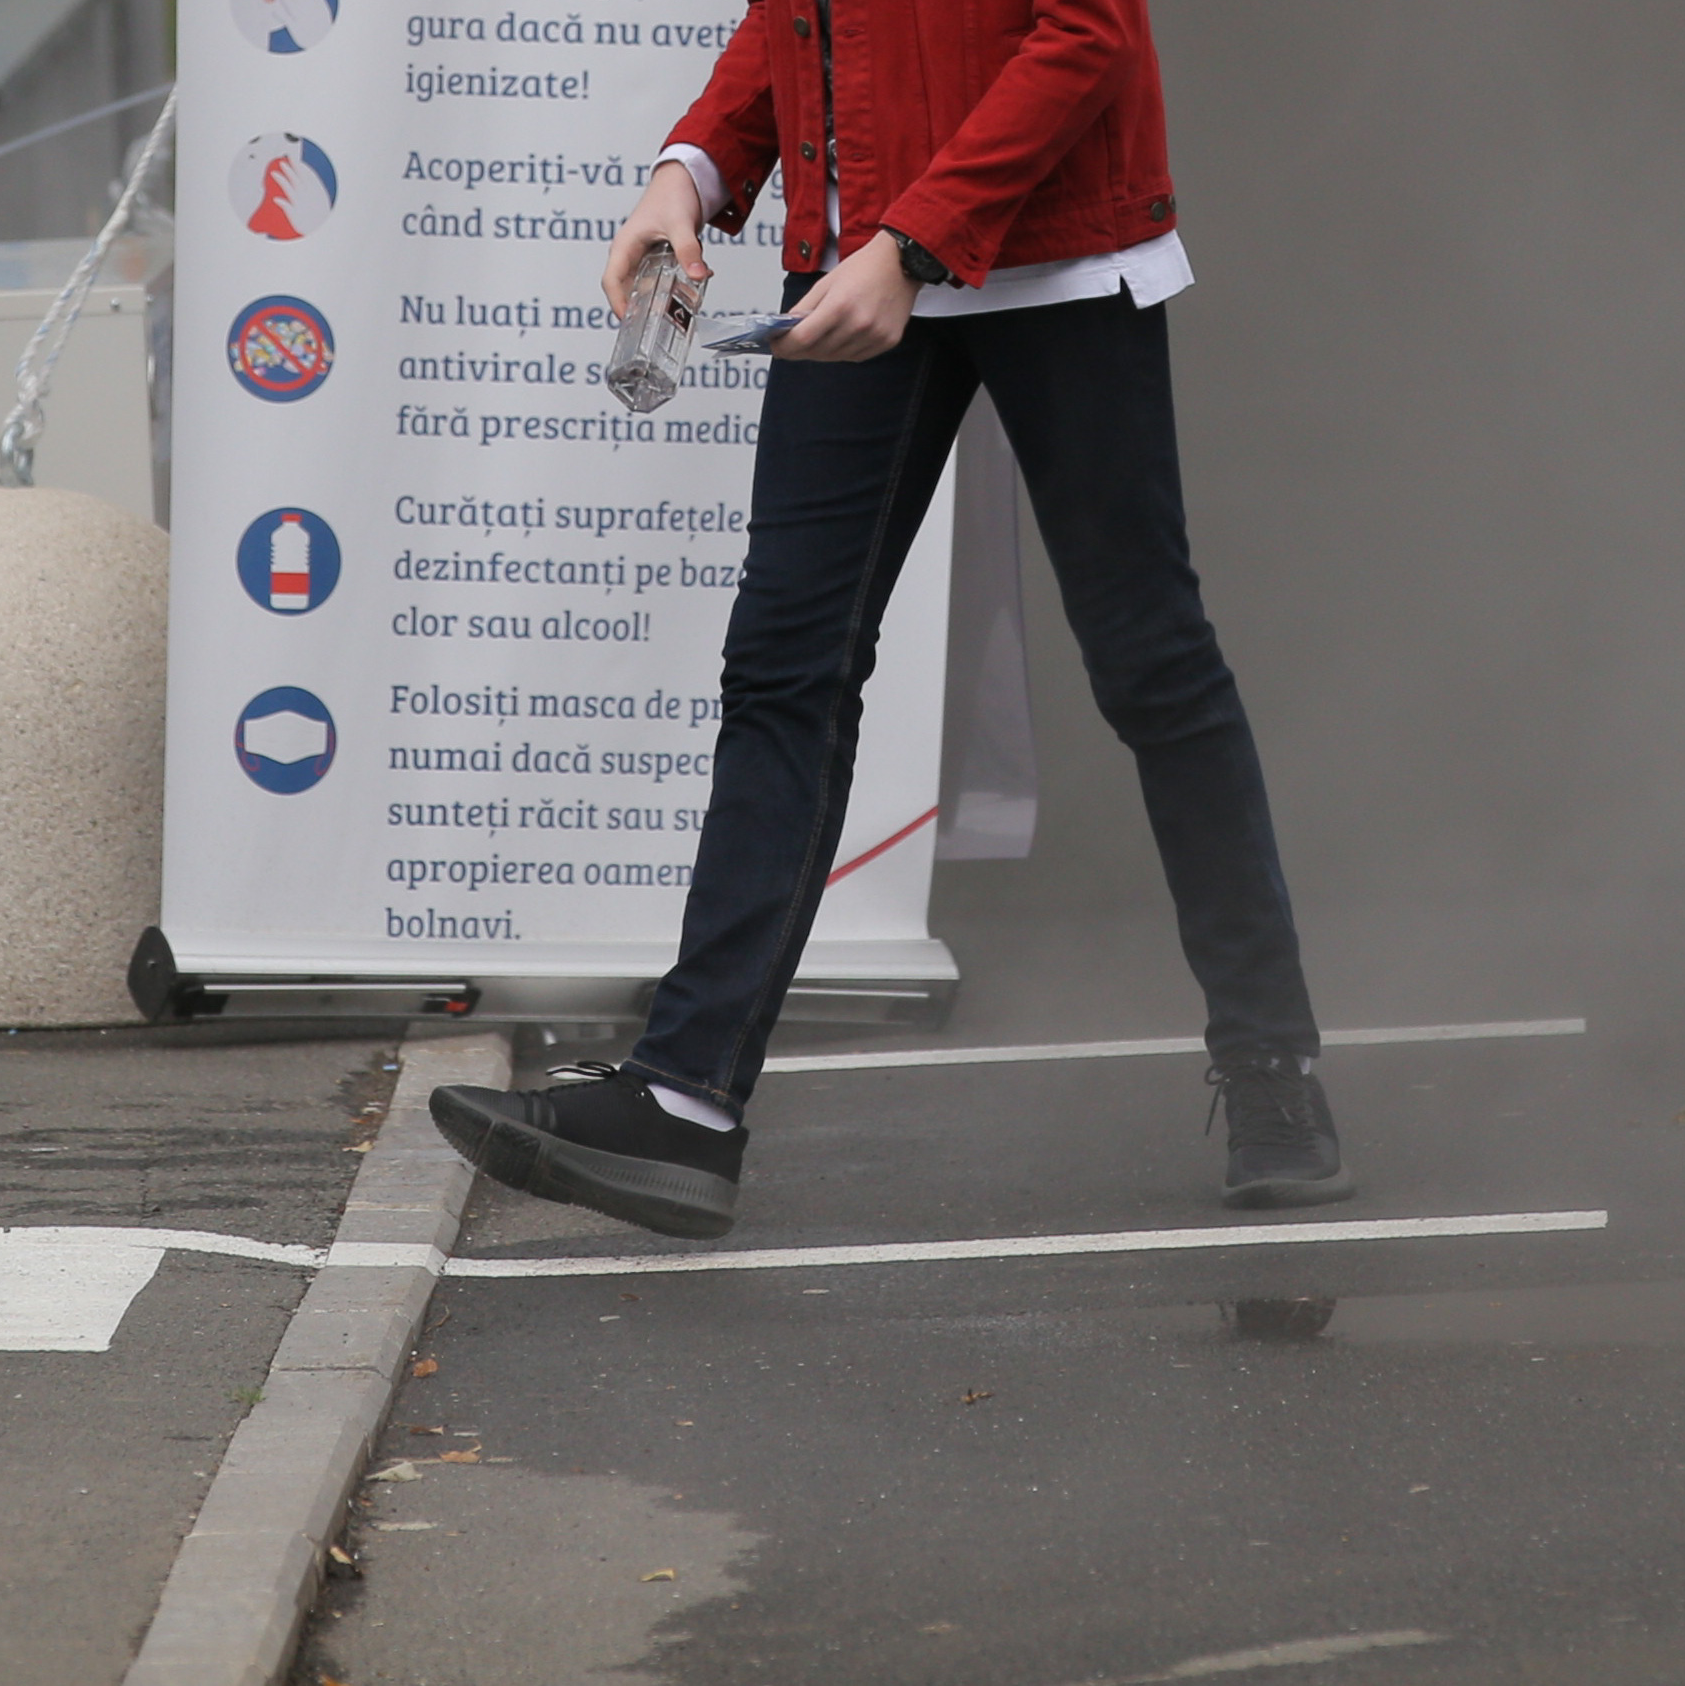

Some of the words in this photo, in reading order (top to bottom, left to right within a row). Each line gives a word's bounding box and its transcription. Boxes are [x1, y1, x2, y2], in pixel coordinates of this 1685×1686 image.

[406, 15, 486, 47] gura
[495, 10, 585, 44] dacă
[594, 21, 642, 46] nu
[405, 62, 590, 104] igienizate!
[402, 149, 625, 194] Acoperiți-vă
[401, 203, 483, 238] când
[493, 209, 627, 243] strănu
[399, 294, 446, 325] Nu
[455, 294, 541, 338] luați
[398, 350, 577, 385] antivirale
[678, 358, 768, 390] ntibio
[396, 403, 470, 438] fără
[479, 409, 656, 451] prescriția
[664, 413, 759, 448] medic
[394, 494, 546, 538] Curățați
[555, 499, 744, 541] suprafețele
[392, 548, 627, 594] dezinfectanți
[633, 563, 672, 595] pe
[391, 604, 459, 638] clor
[467, 614, 532, 640] sau
[541, 609, 651, 642] alcool!
[389, 683, 519, 726] Folosiți
[528, 694, 636, 720] masca
[644, 688, 681, 720] de
[388, 741, 503, 772] numai
[511, 741, 592, 774] dacă
[600, 751, 711, 784] suspec
[387, 797, 510, 838] sunteți
[518, 798, 599, 830] răcit
[606, 806, 664, 831] sau
[386, 852, 575, 892] apropierea
[583, 862, 693, 888] oamen
[384, 906, 521, 940] bolnavi.
